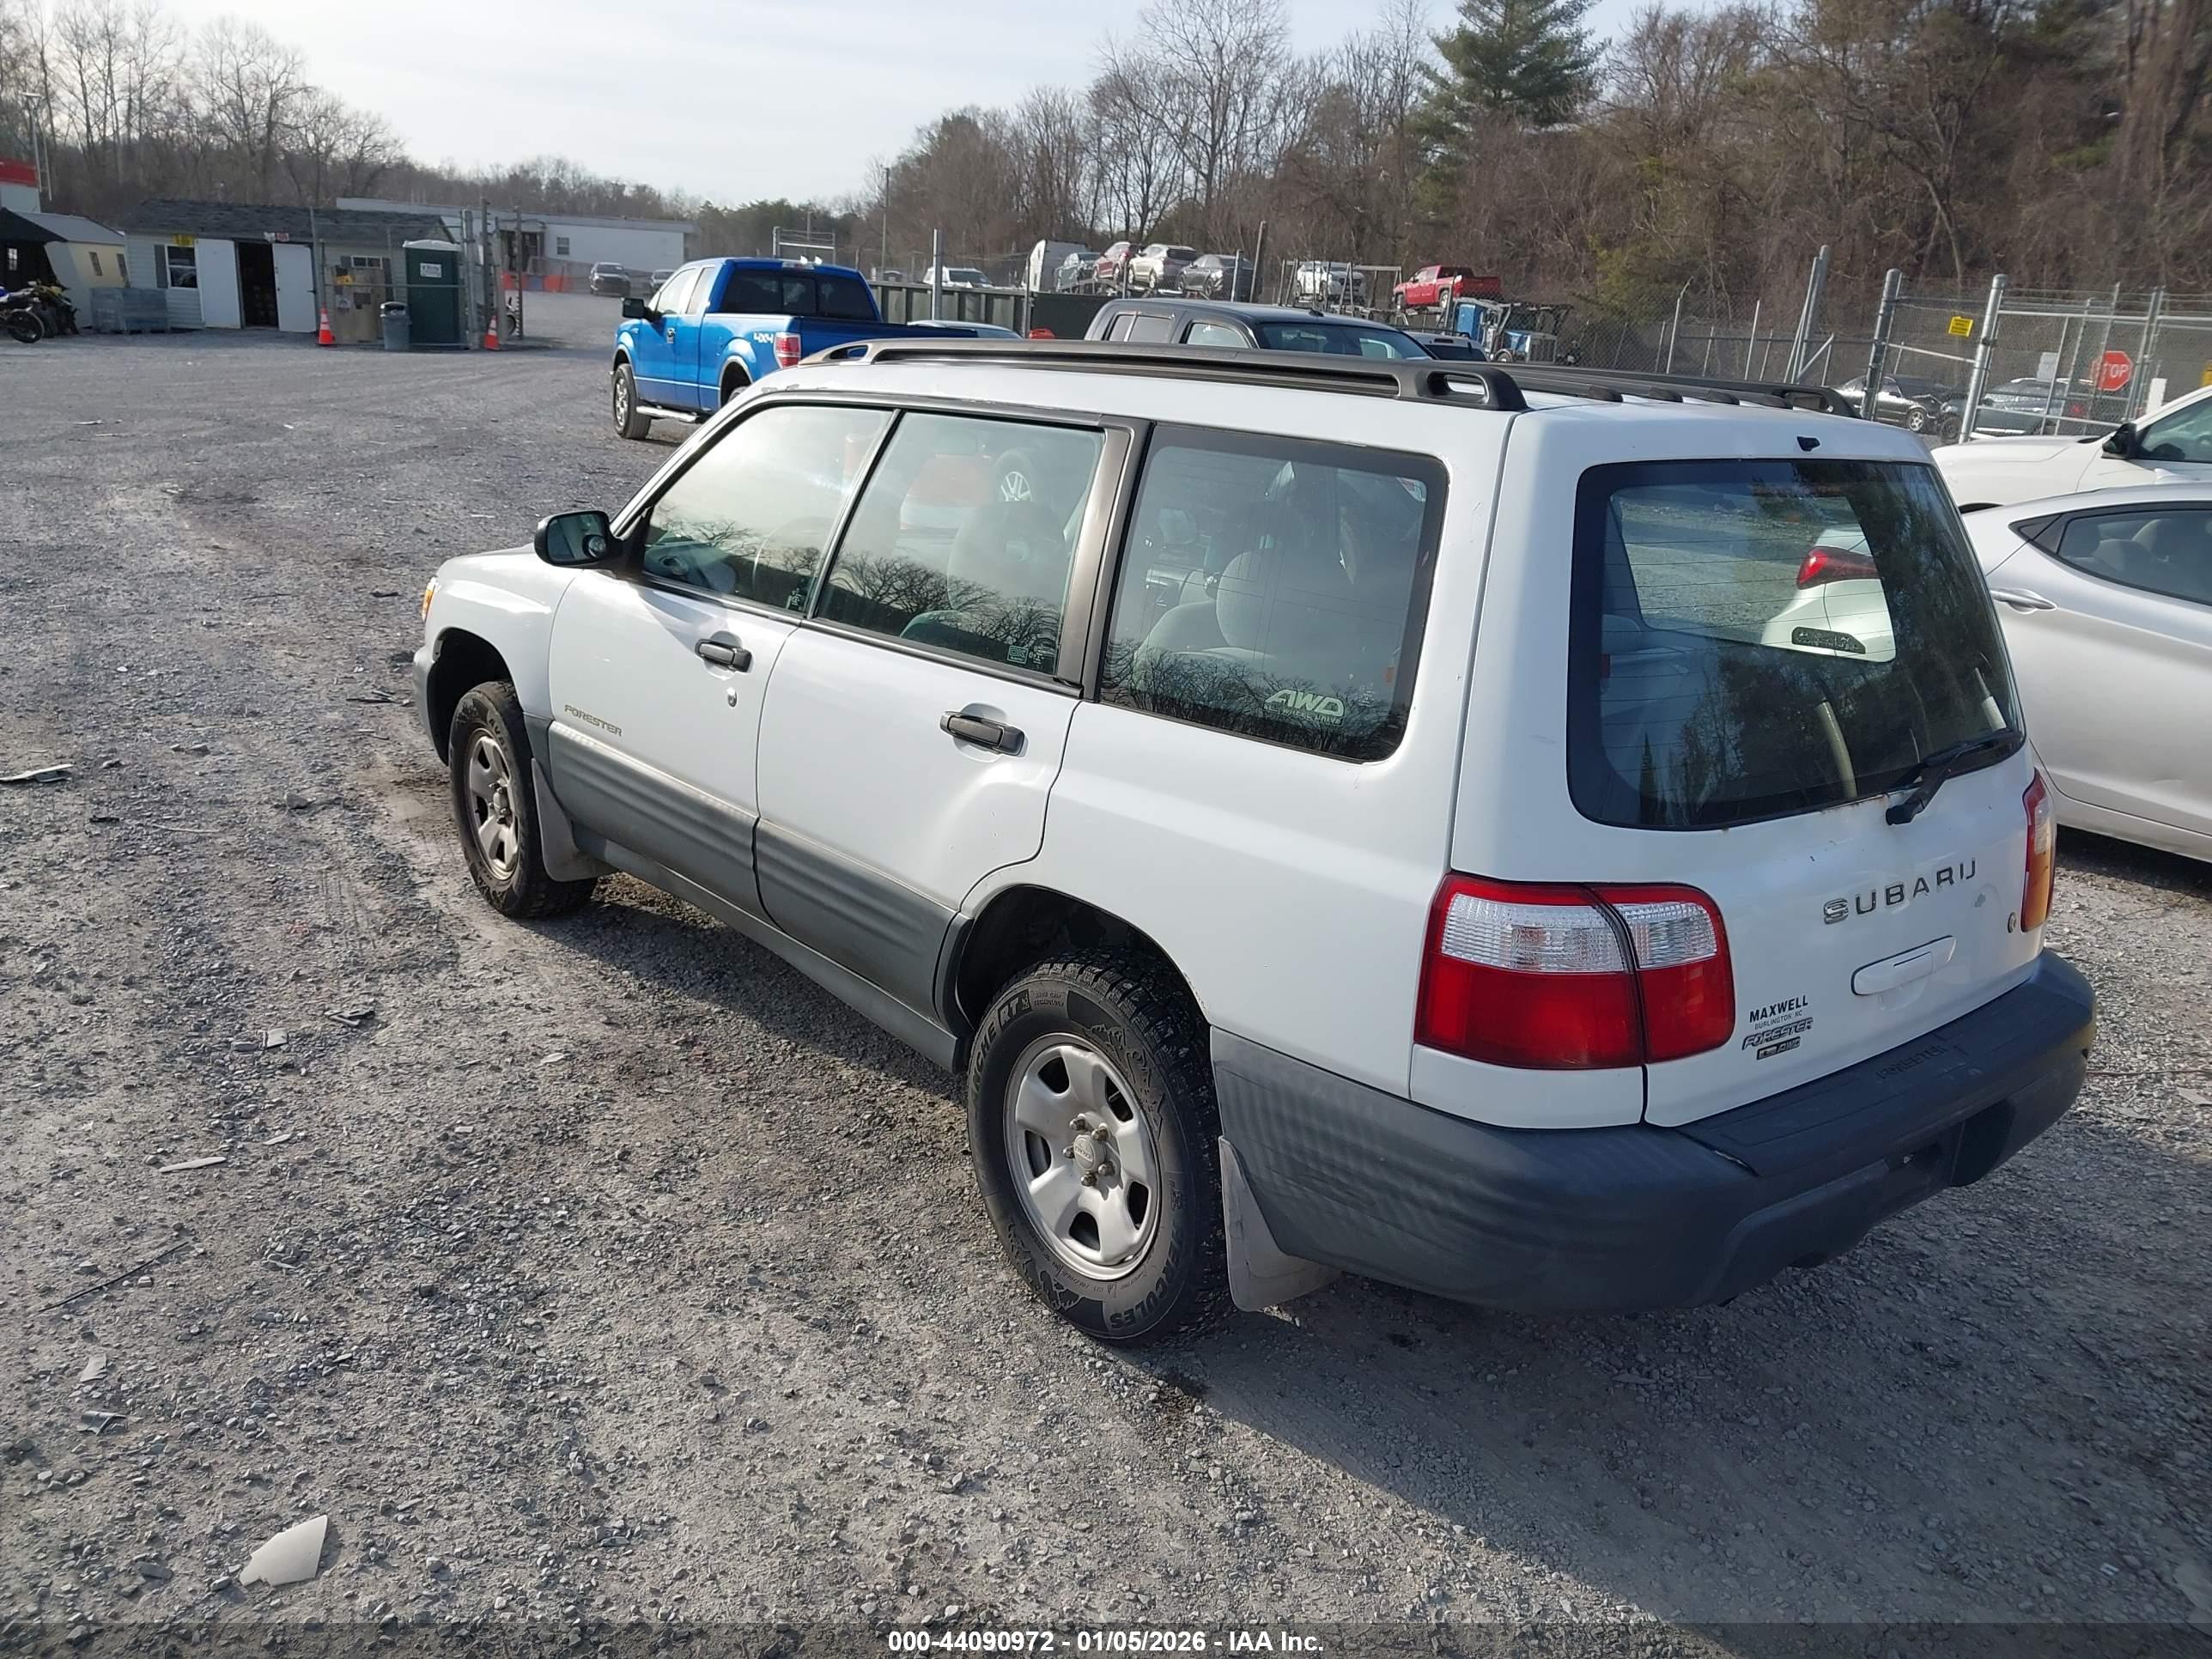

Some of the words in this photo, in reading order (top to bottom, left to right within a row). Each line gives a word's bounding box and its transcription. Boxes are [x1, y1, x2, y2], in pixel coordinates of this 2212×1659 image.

[2098, 363, 2130, 379] TOP
[1264, 689, 1345, 717] AWD
[564, 703, 623, 738] FORESTER
[1823, 859, 1976, 925] SUBARU
[1749, 995, 1808, 1023] MAXWELL
[1754, 1013, 1792, 1030] BURLINGTON
[1741, 1017, 1814, 1050] FORESTER
